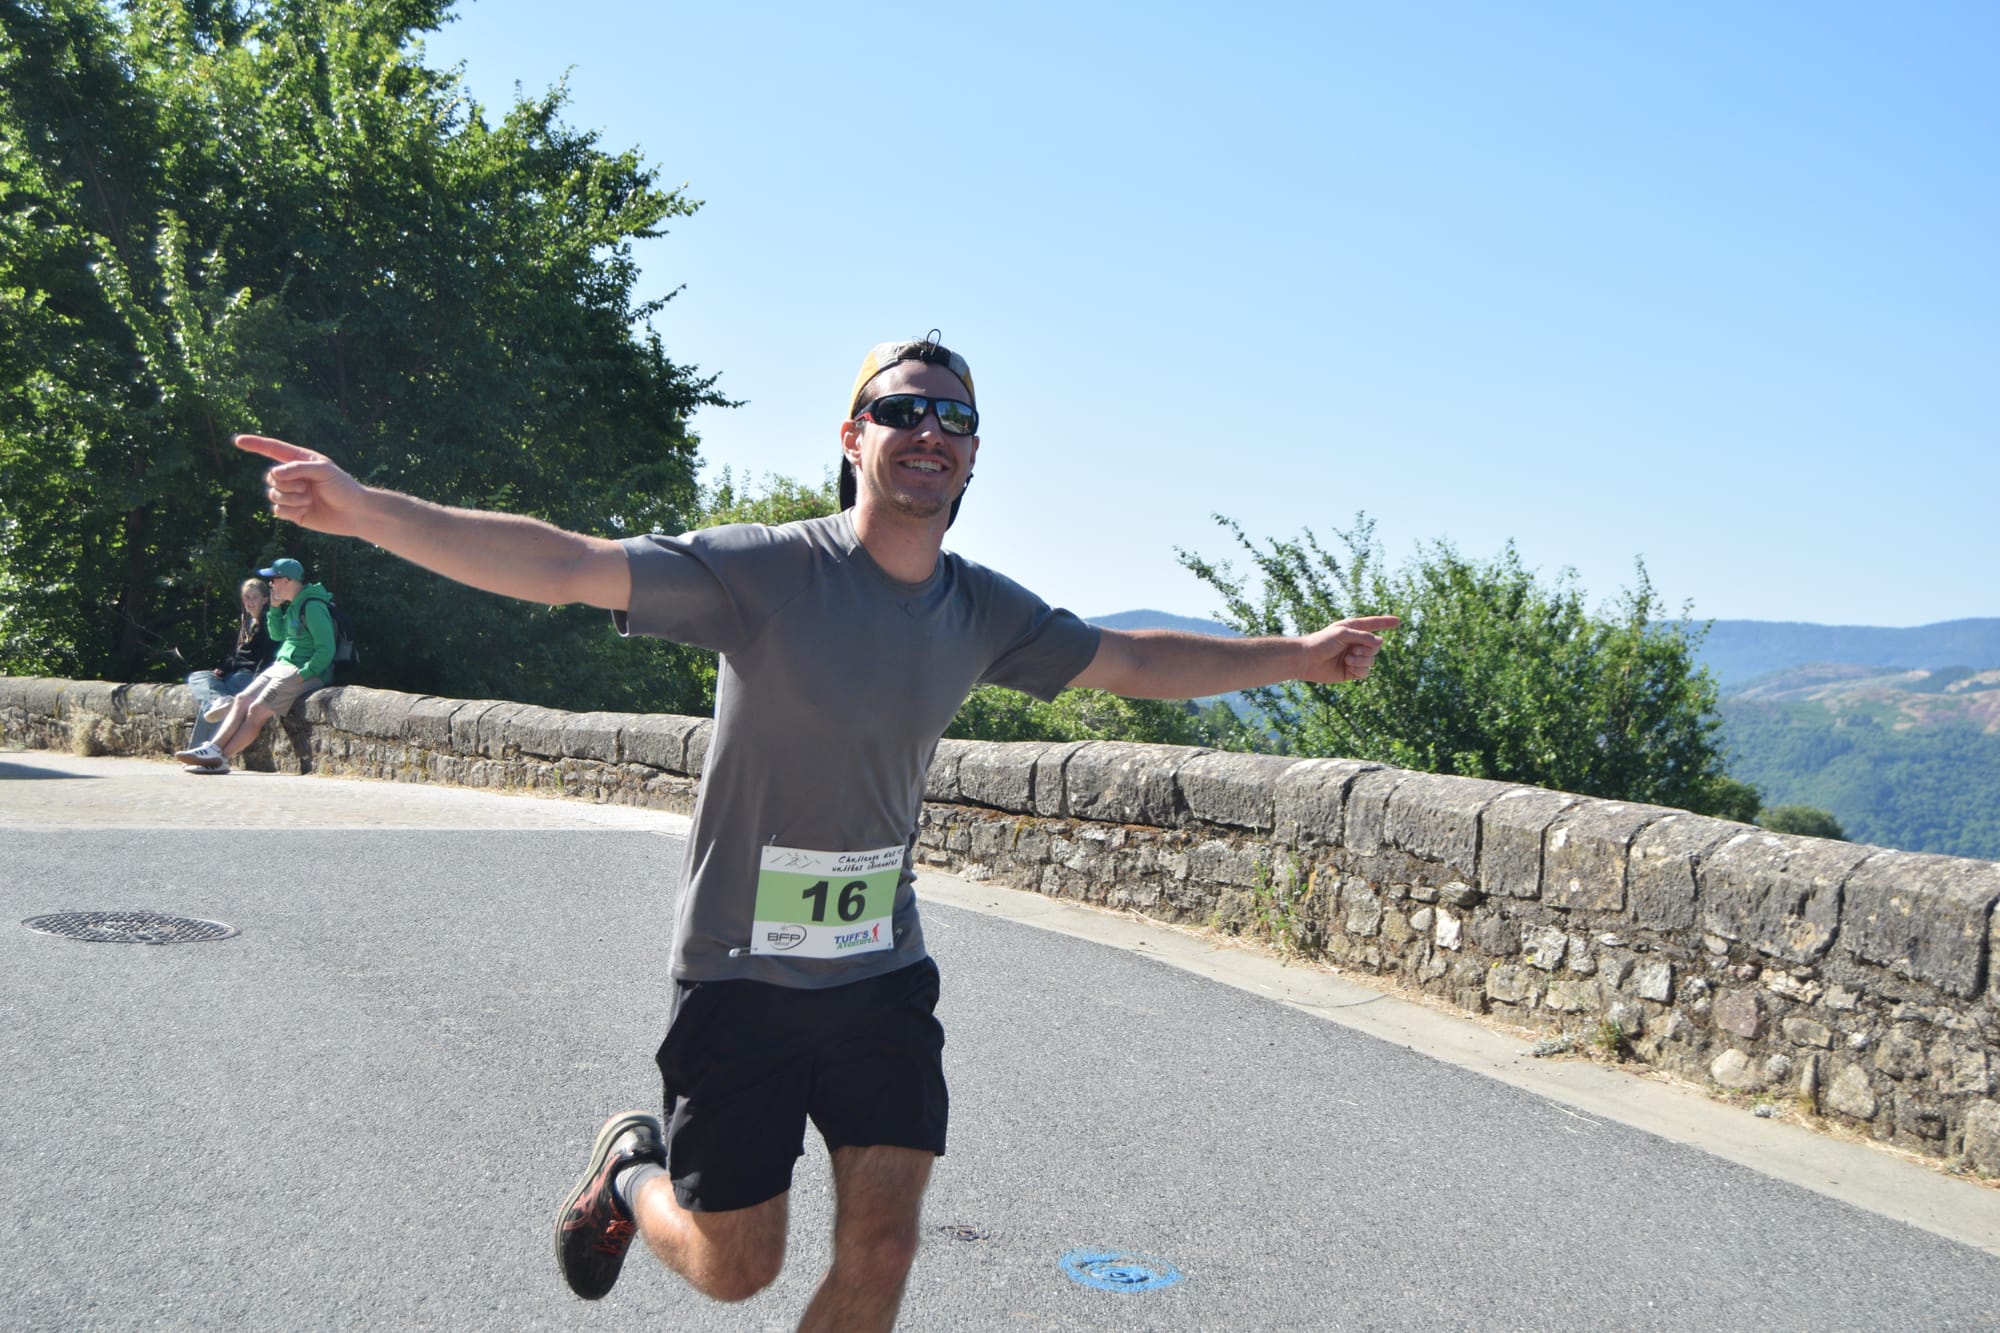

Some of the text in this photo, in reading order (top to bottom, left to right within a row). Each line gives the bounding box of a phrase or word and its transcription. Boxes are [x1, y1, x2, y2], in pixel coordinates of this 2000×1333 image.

[838, 854, 880, 865] Challenge
[802, 880, 868, 922] 16
[767, 932, 801, 942] BFP
